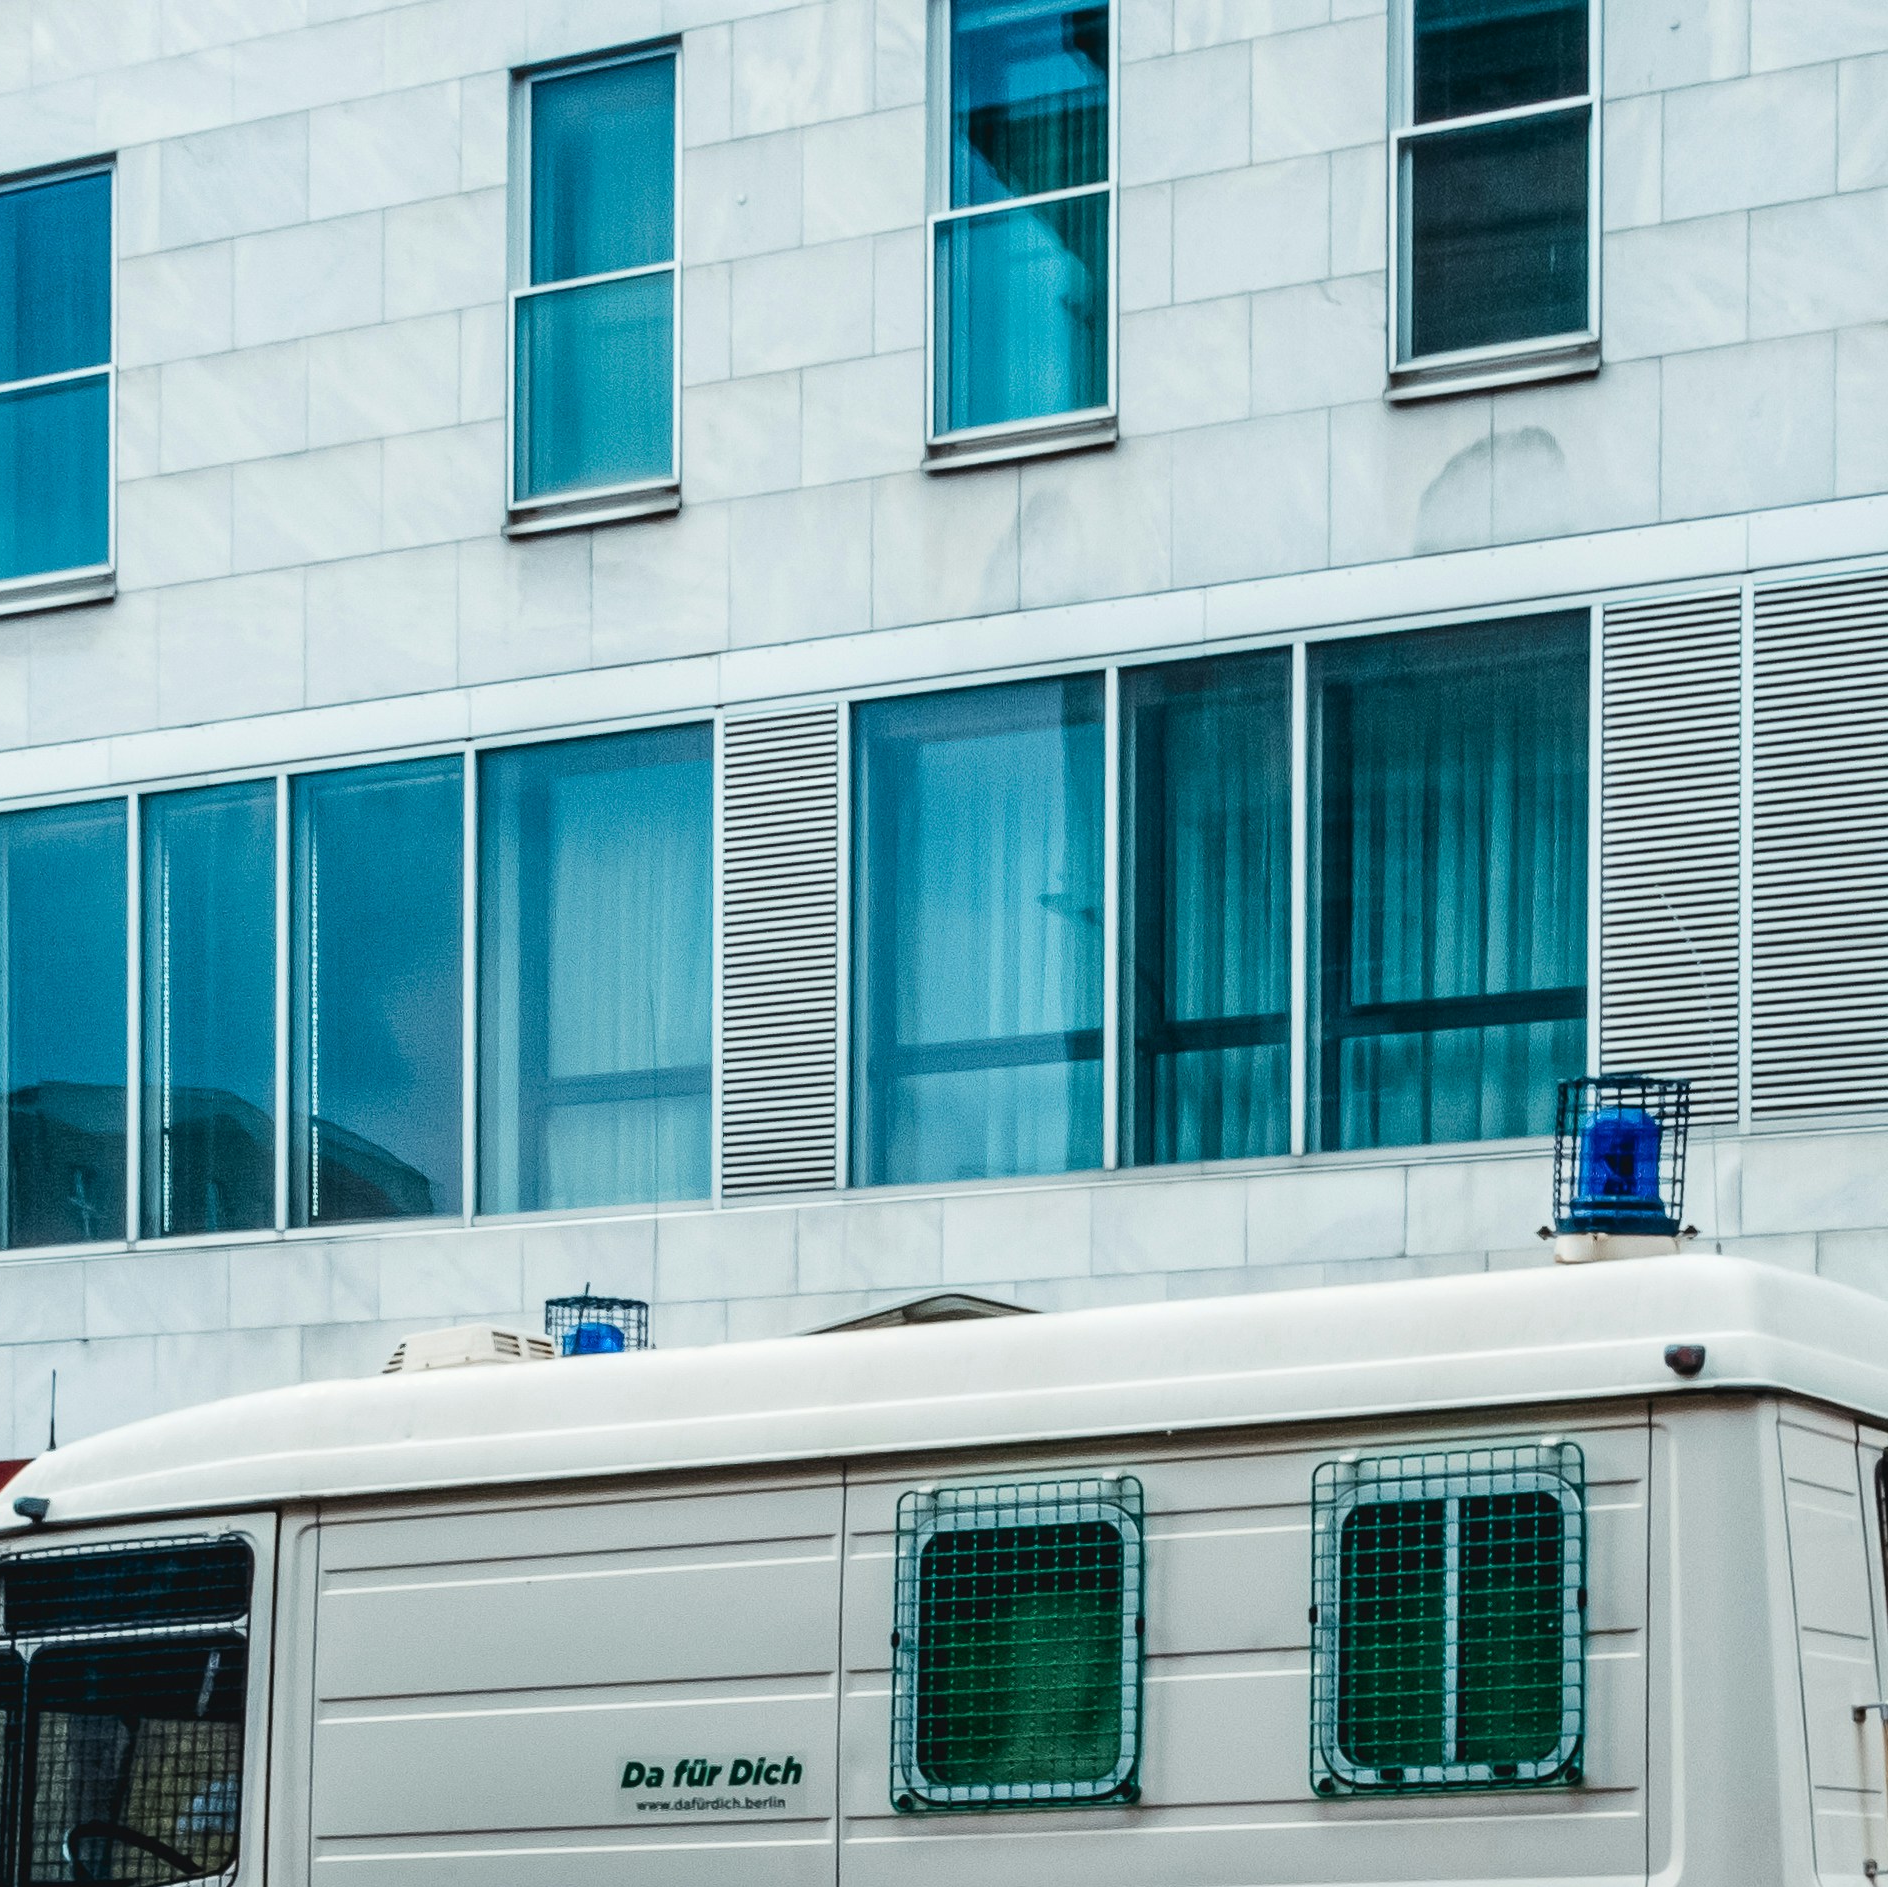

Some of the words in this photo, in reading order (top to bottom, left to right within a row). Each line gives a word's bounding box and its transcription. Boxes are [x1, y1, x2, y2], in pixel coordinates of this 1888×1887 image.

[620, 1761, 665, 1789] Da
[672, 1758, 723, 1788] für
[727, 1755, 804, 1787] Dich
